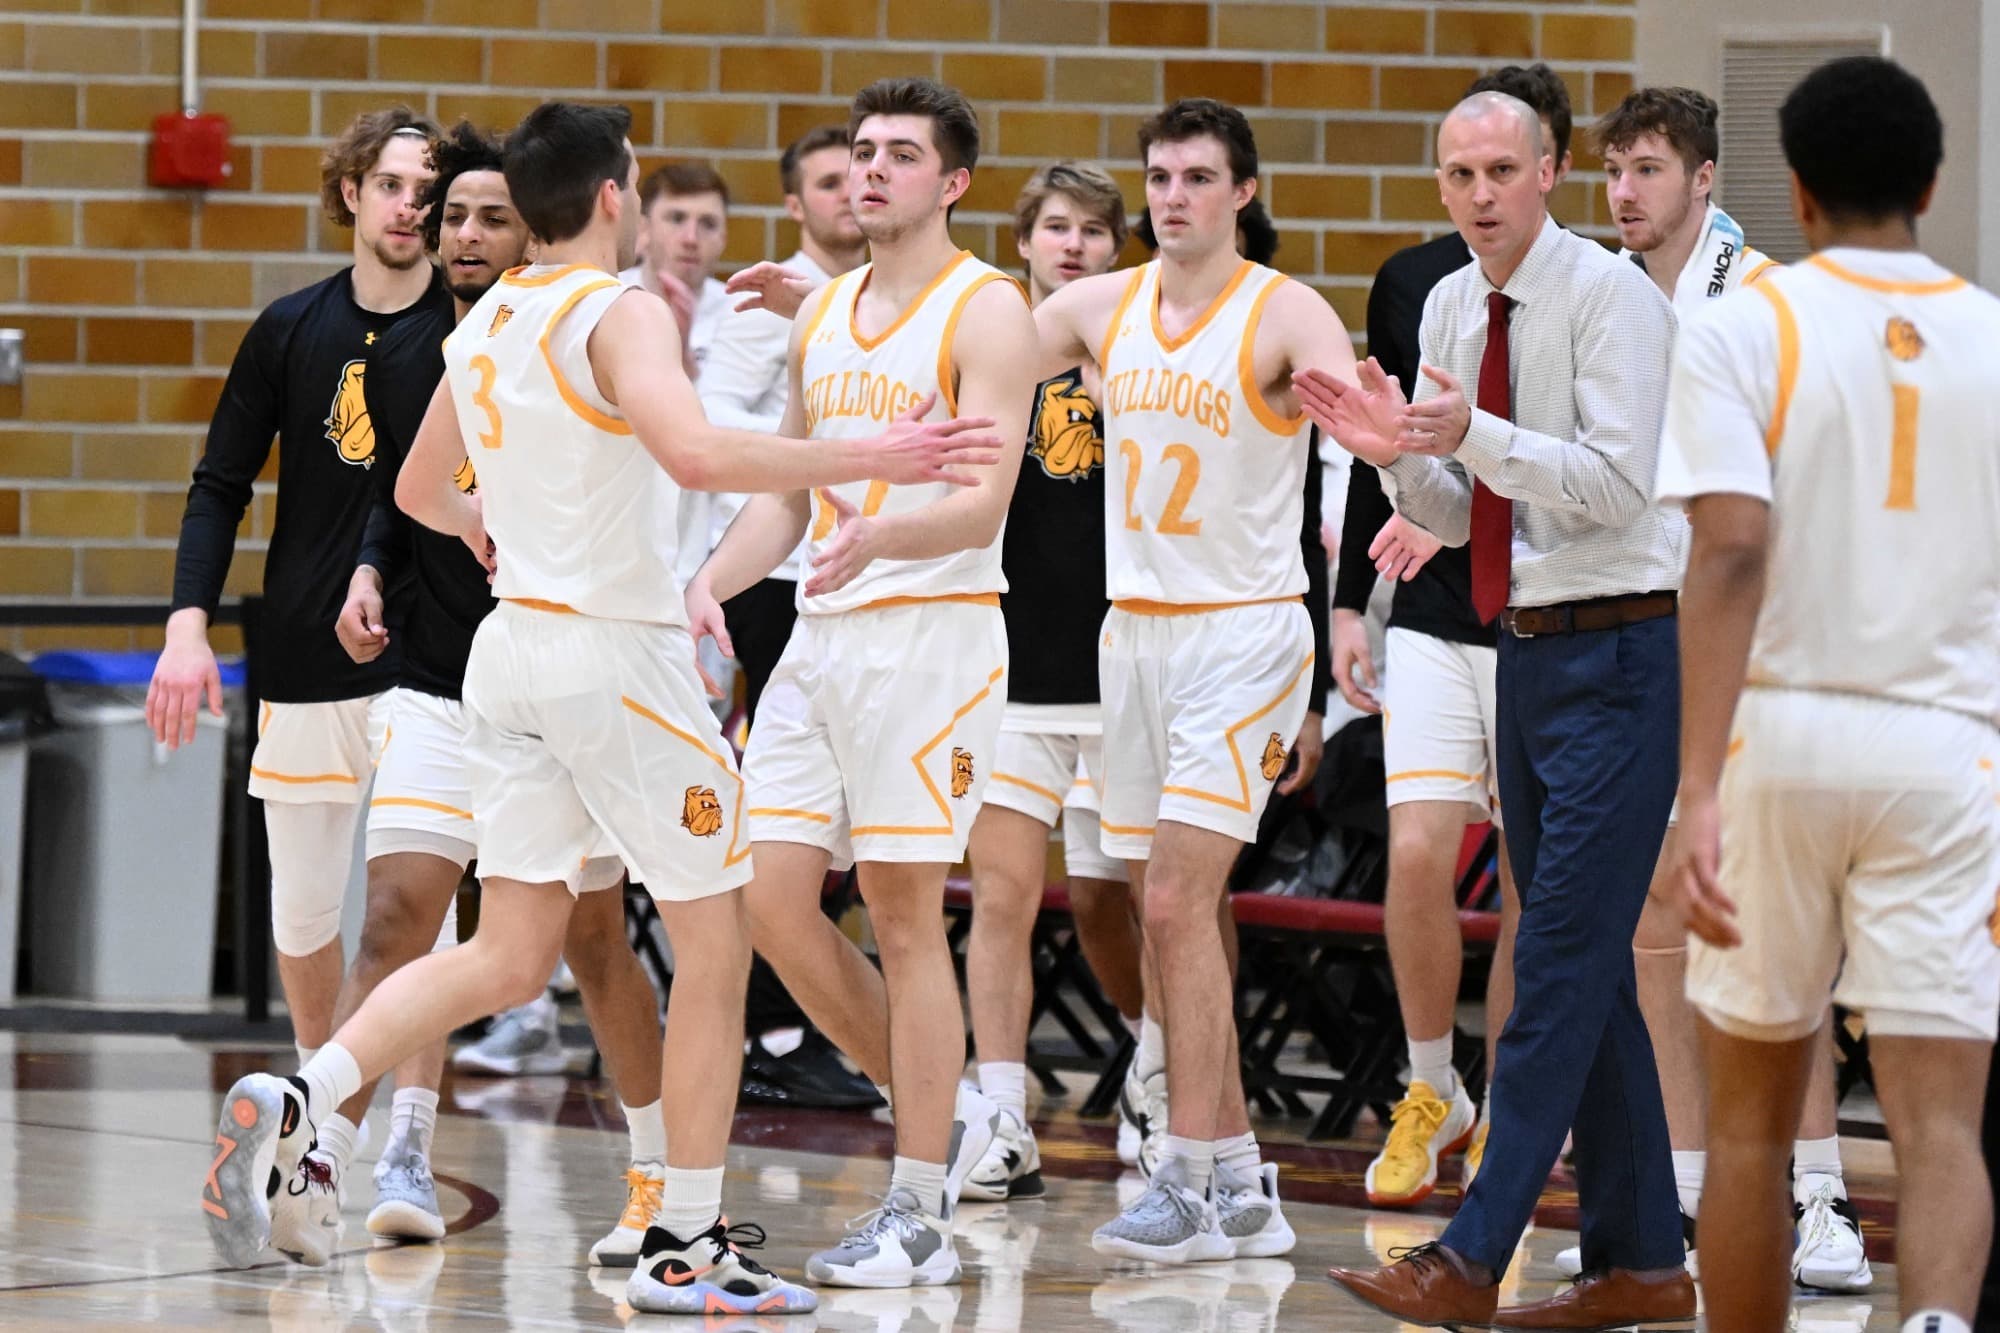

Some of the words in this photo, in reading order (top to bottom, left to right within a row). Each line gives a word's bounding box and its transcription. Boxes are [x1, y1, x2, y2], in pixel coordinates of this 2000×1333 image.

[469, 354, 503, 449] 3
[1883, 382, 1919, 511] 1
[1119, 438, 1203, 537] 22
